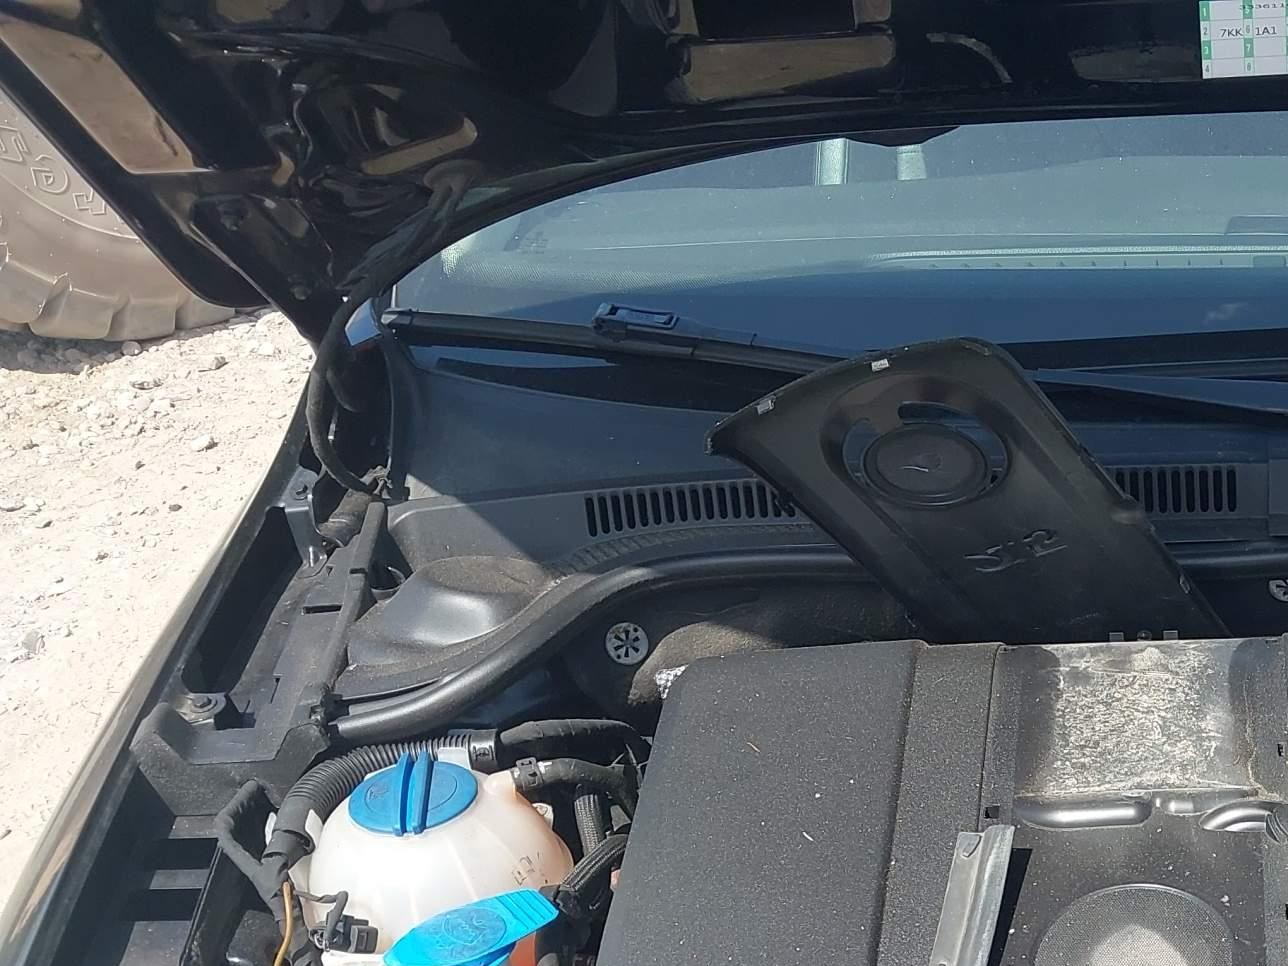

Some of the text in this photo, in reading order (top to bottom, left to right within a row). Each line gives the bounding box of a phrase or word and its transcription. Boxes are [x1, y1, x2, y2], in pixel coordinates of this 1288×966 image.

[1203, 28, 1208, 36] 2
[1220, 28, 1243, 38] 7KK
[1255, 26, 1277, 36] 1A1
[1205, 64, 1210, 72] 4
